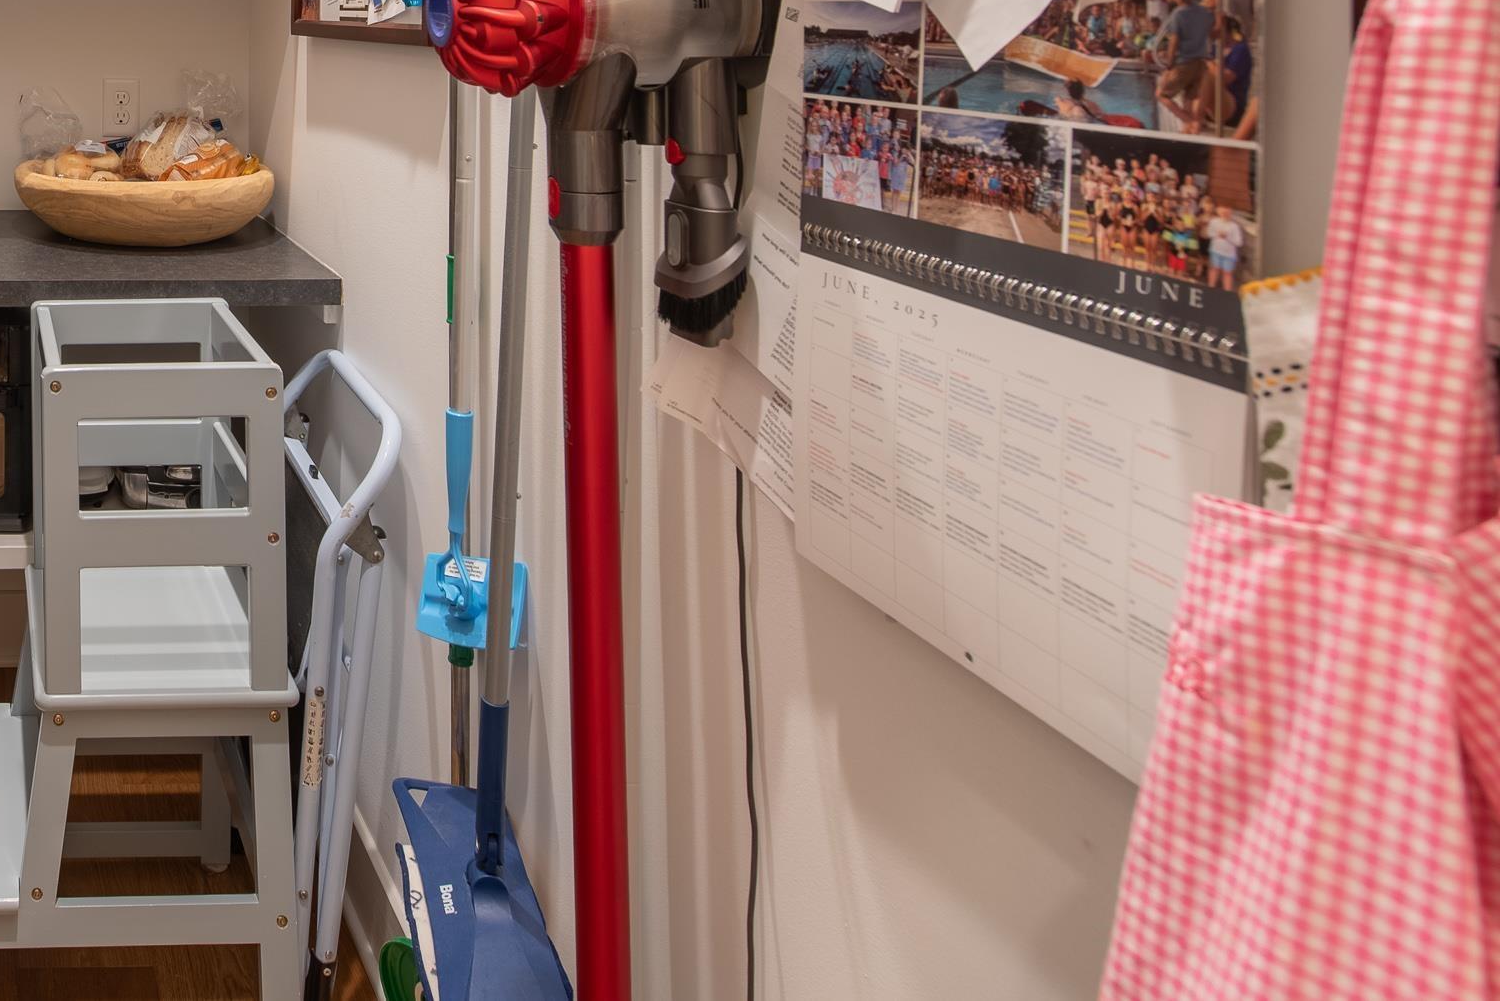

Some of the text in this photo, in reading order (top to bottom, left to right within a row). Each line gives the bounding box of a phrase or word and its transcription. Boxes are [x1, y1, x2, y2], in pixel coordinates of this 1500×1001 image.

[821, 272, 940, 328] JUNE, 2025
[1115, 270, 1204, 308] JUNE
[439, 883, 455, 915] Bona
